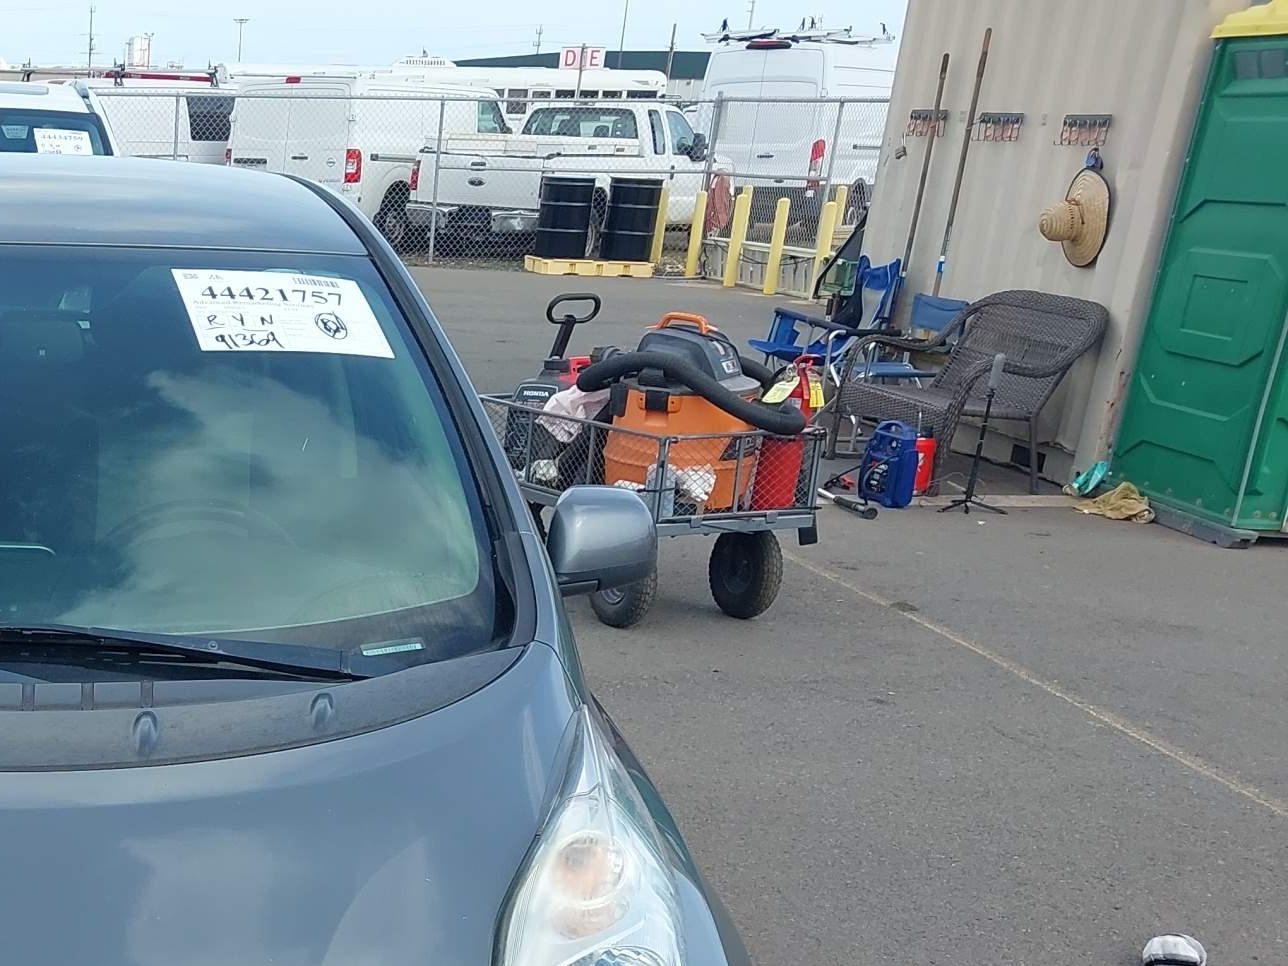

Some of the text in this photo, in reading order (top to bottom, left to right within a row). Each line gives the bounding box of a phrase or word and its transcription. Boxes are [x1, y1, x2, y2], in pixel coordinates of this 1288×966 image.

[564, 50, 600, 66] D E
[201, 286, 342, 306] 44421757
[260, 314, 274, 326] N
